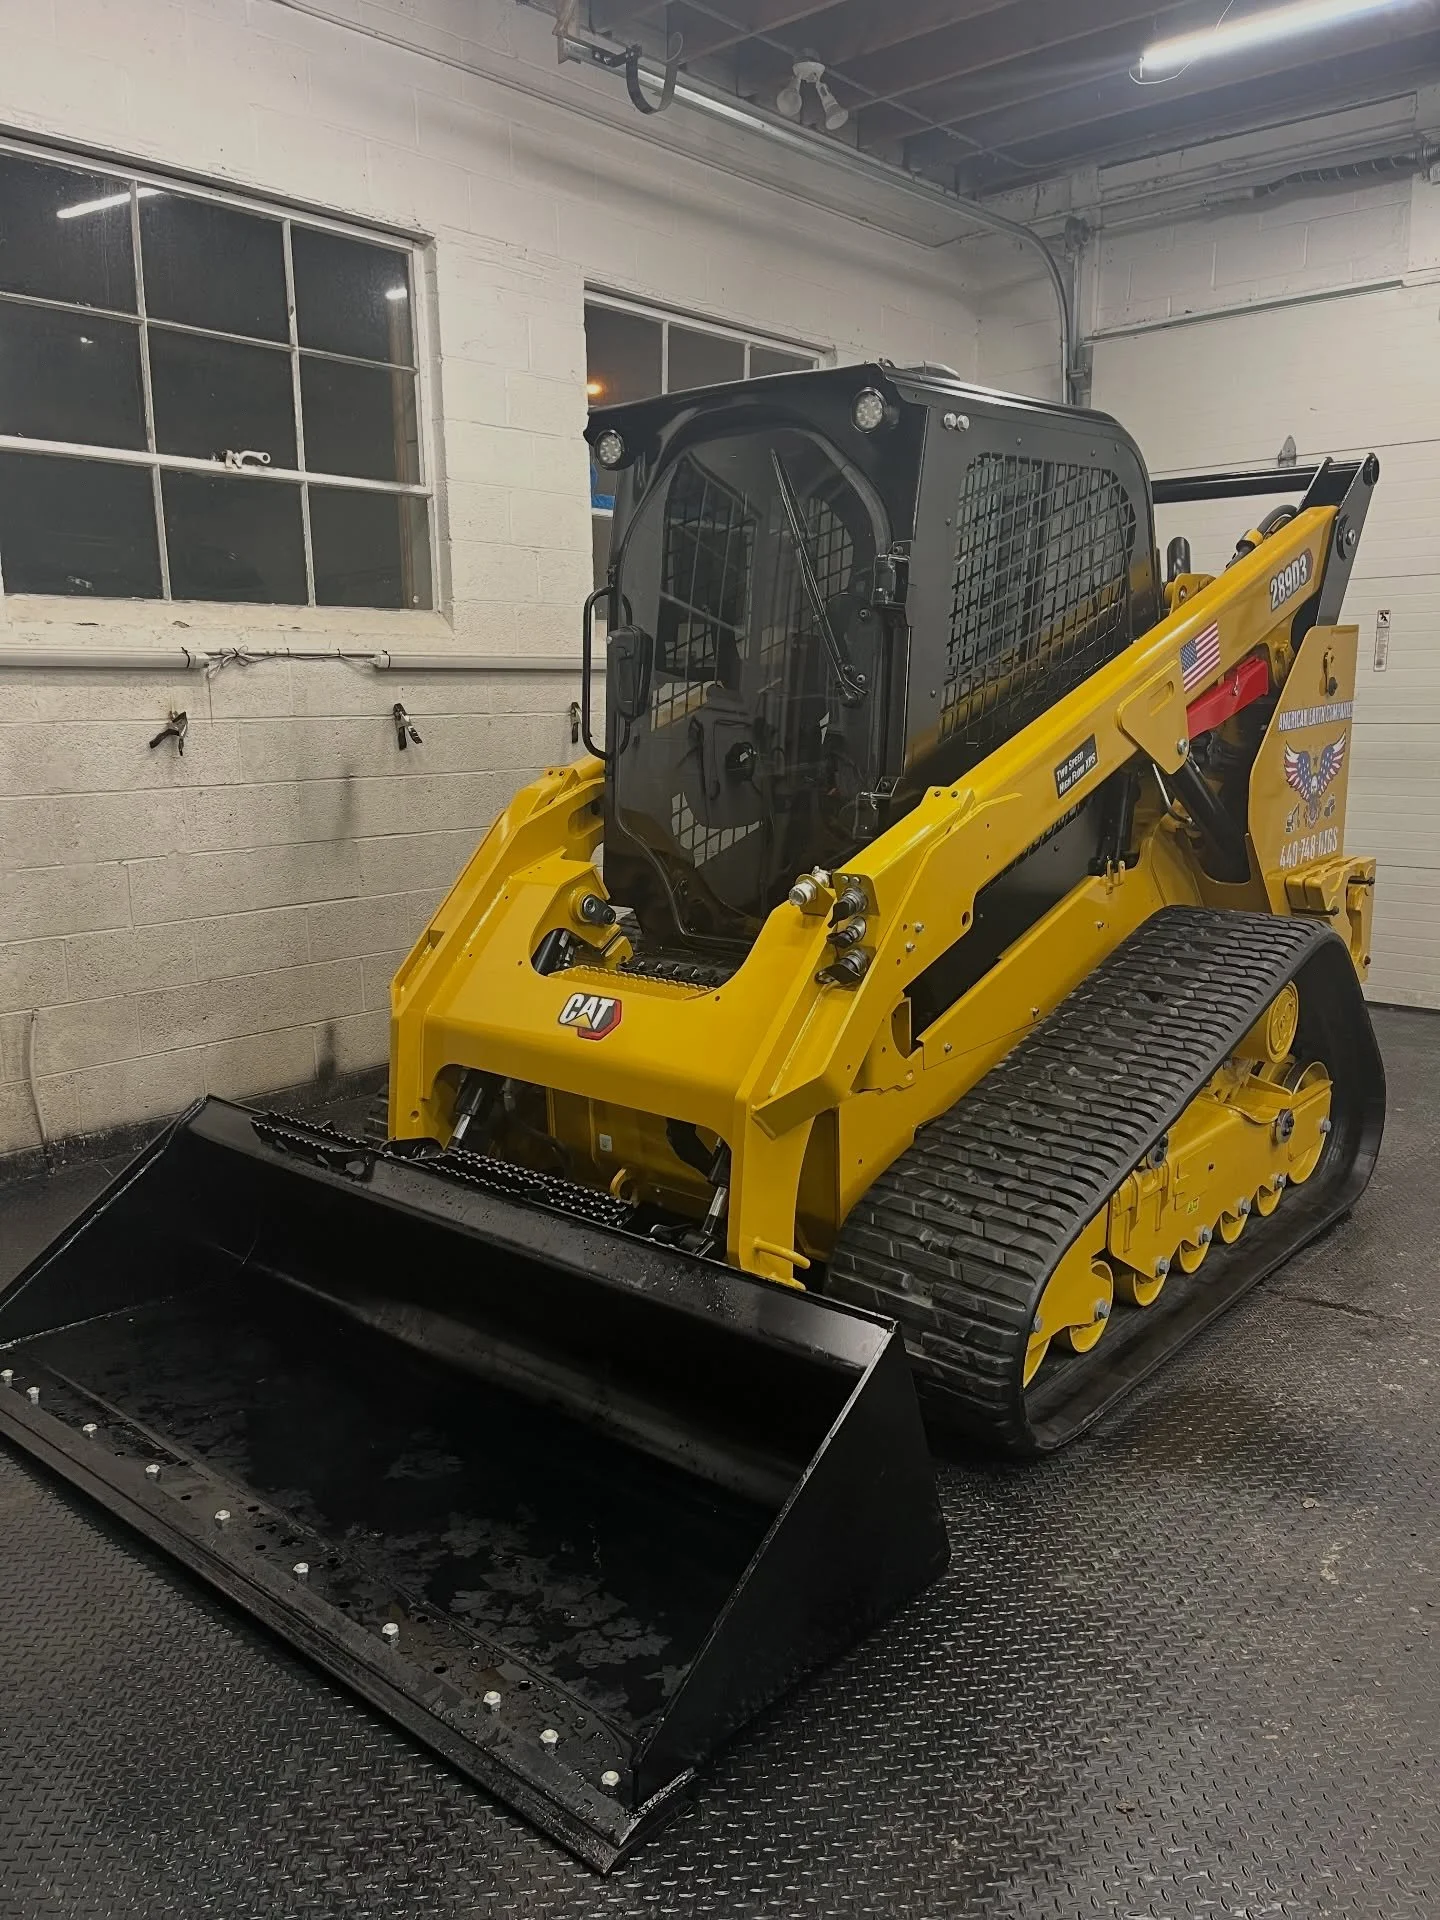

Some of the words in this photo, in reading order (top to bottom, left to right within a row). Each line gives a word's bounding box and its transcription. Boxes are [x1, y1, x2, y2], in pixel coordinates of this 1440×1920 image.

[1270, 554, 1307, 610] 289D3
[1279, 709, 1308, 731] AMERICAN
[560, 993, 616, 1030] CAT
